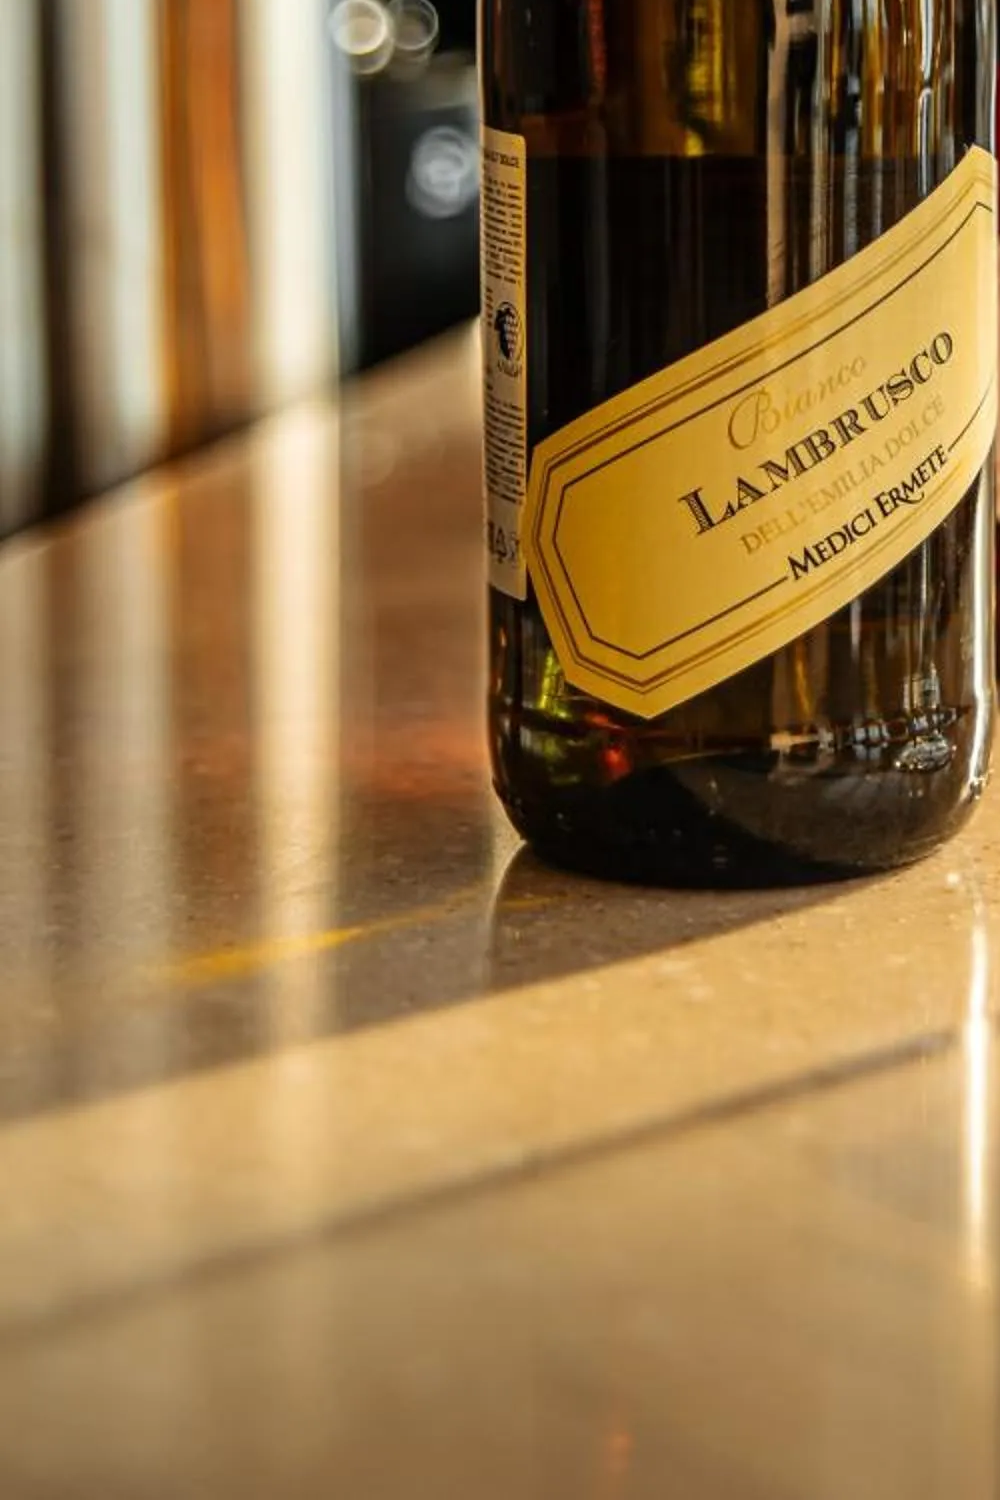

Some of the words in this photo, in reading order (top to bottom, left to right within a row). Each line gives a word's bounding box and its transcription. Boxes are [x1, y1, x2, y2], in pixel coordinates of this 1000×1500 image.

[677, 331, 954, 536] LAMBRUSCO
[727, 354, 867, 451] Bianco
[740, 455, 887, 555] DELL'EMILIA
[884, 394, 946, 461] DOLCE
[786, 507, 878, 581] MEDICI
[873, 444, 949, 518] ERMETE
